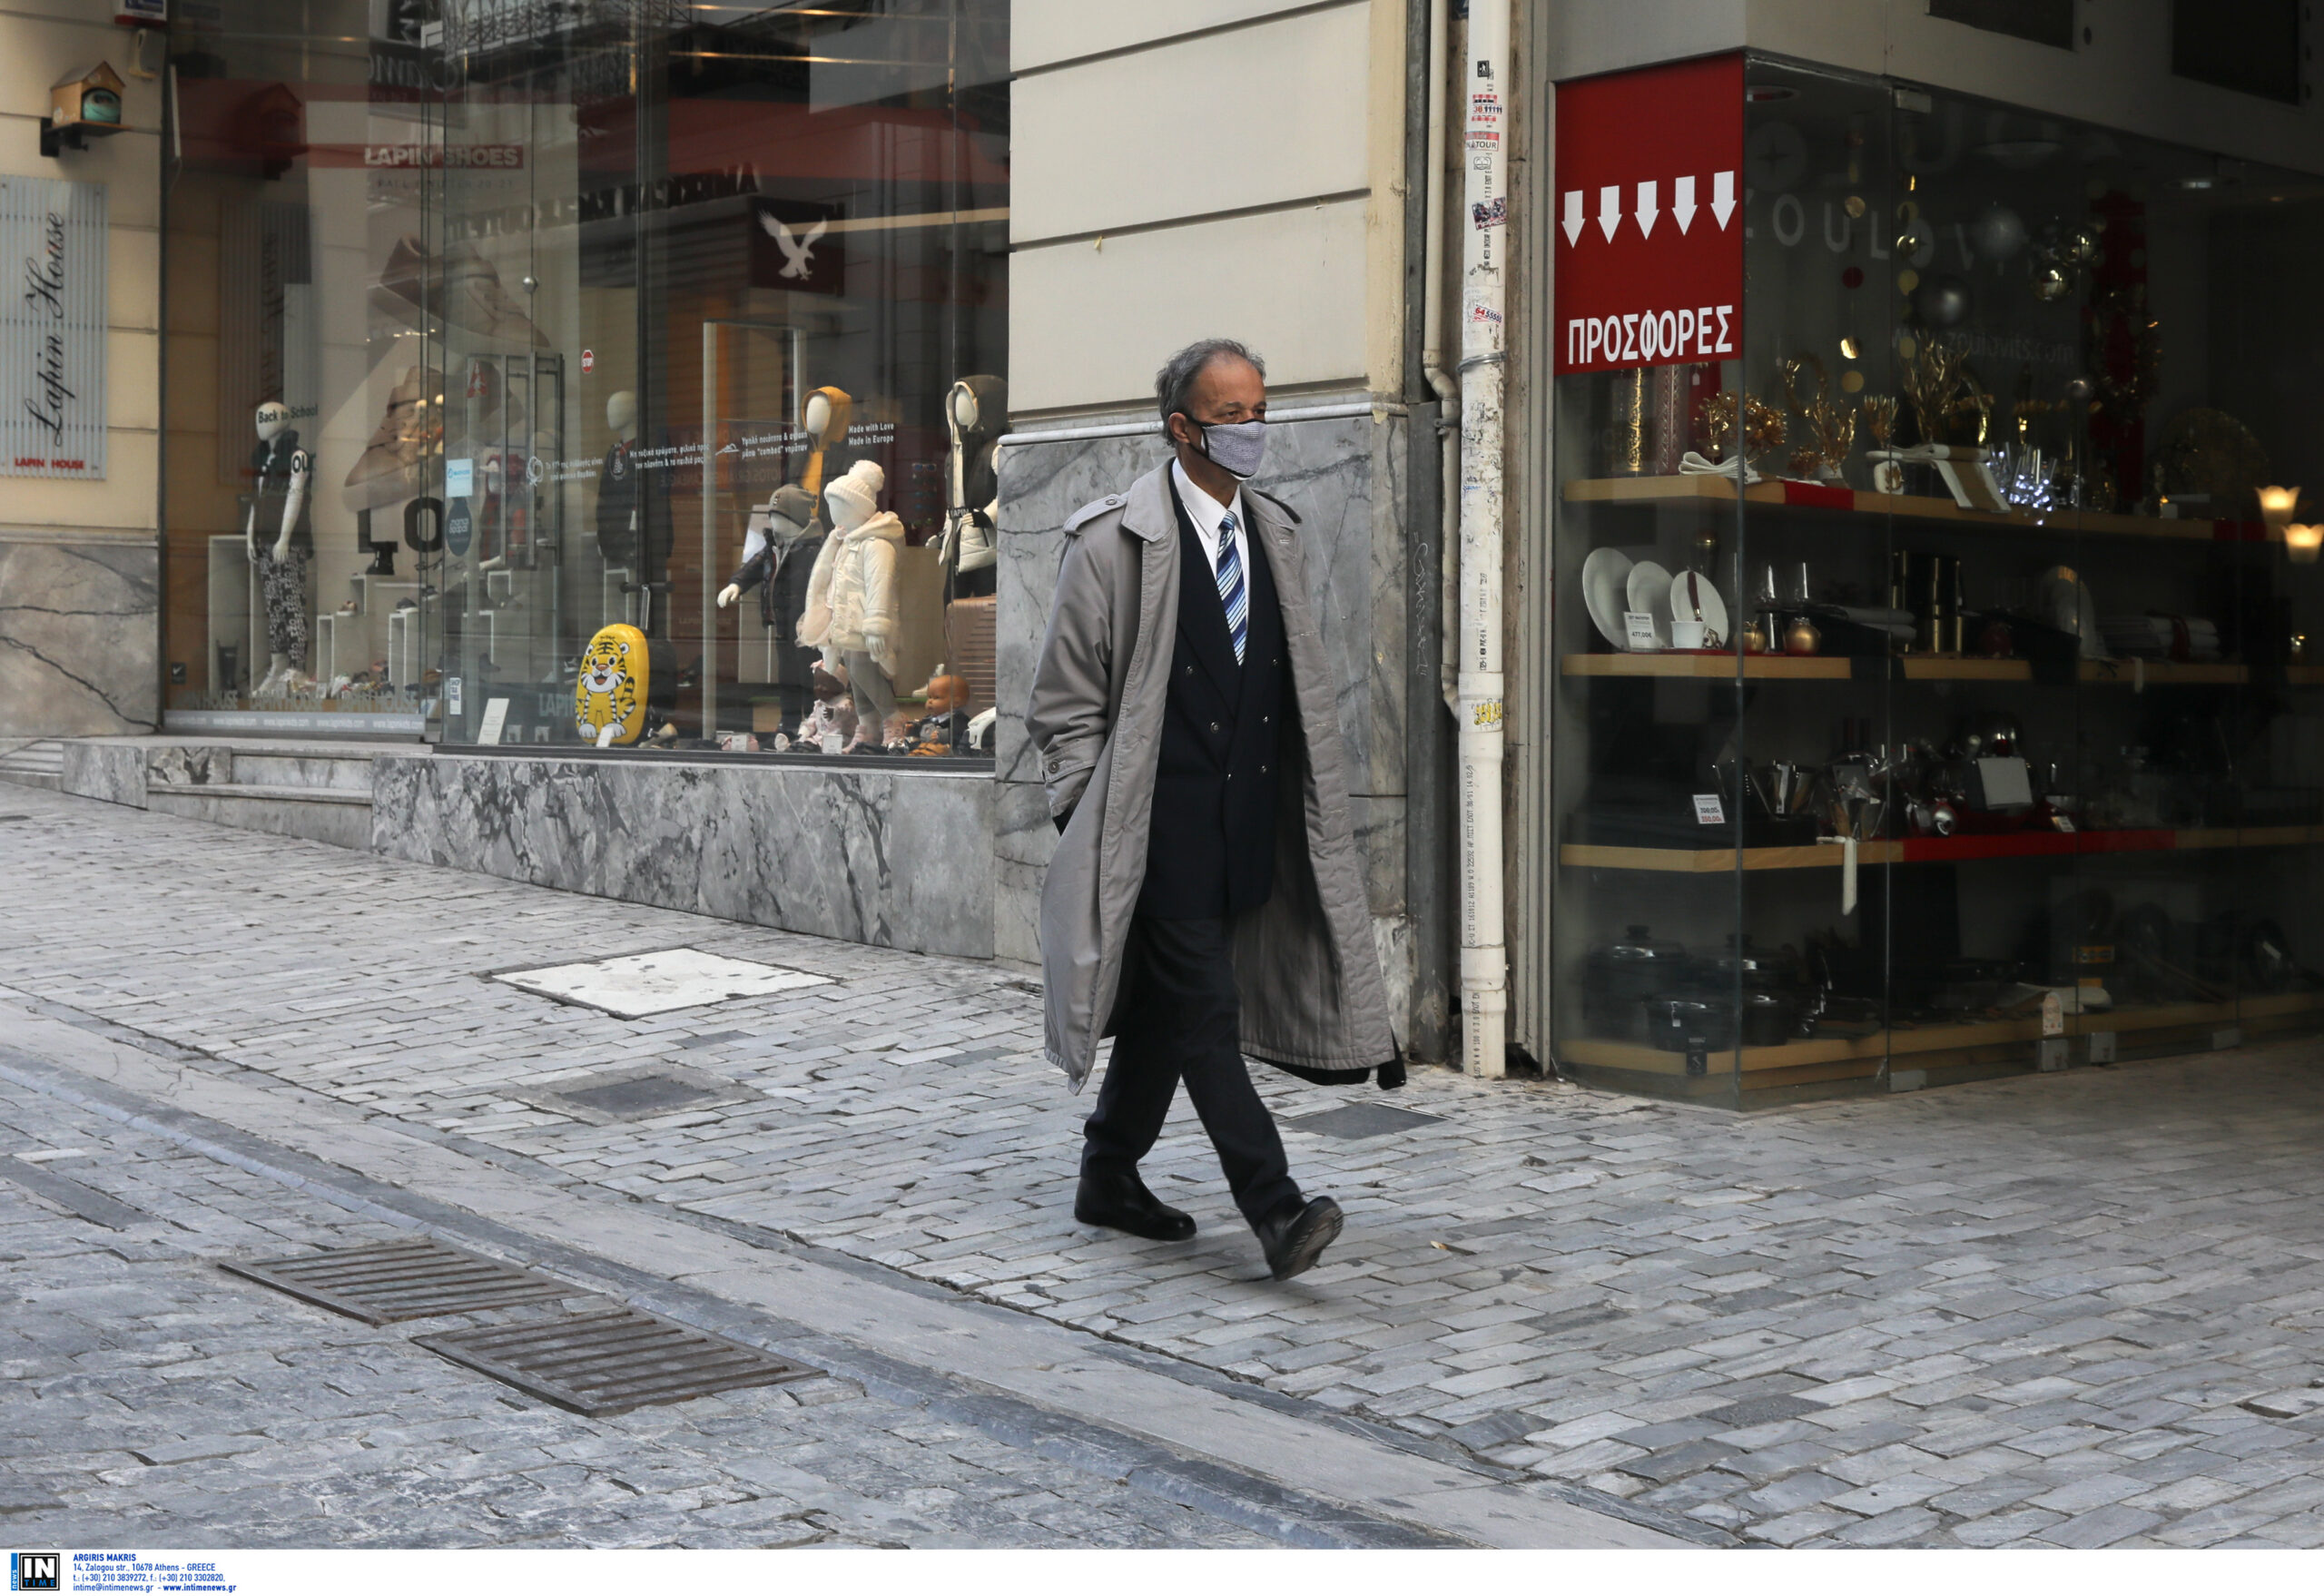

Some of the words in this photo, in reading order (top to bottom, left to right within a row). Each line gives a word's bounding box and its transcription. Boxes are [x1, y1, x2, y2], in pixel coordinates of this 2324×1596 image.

[365, 146, 433, 165] LAPIN
[446, 146, 519, 167] SHOES
[25, 212, 64, 319] House
[1569, 305, 1733, 365] ΠΡΟΣΦΟΡΕΣ
[25, 333, 75, 448] Lapin
[258, 409, 278, 424] Back
[290, 403, 319, 419] School
[849, 424, 863, 434] Made
[865, 422, 879, 432] with
[880, 422, 894, 431] Love
[849, 436, 863, 446] Made
[872, 434, 894, 444] Europe
[15, 457, 45, 468] LAPIN
[52, 458, 85, 470] HOUSE
